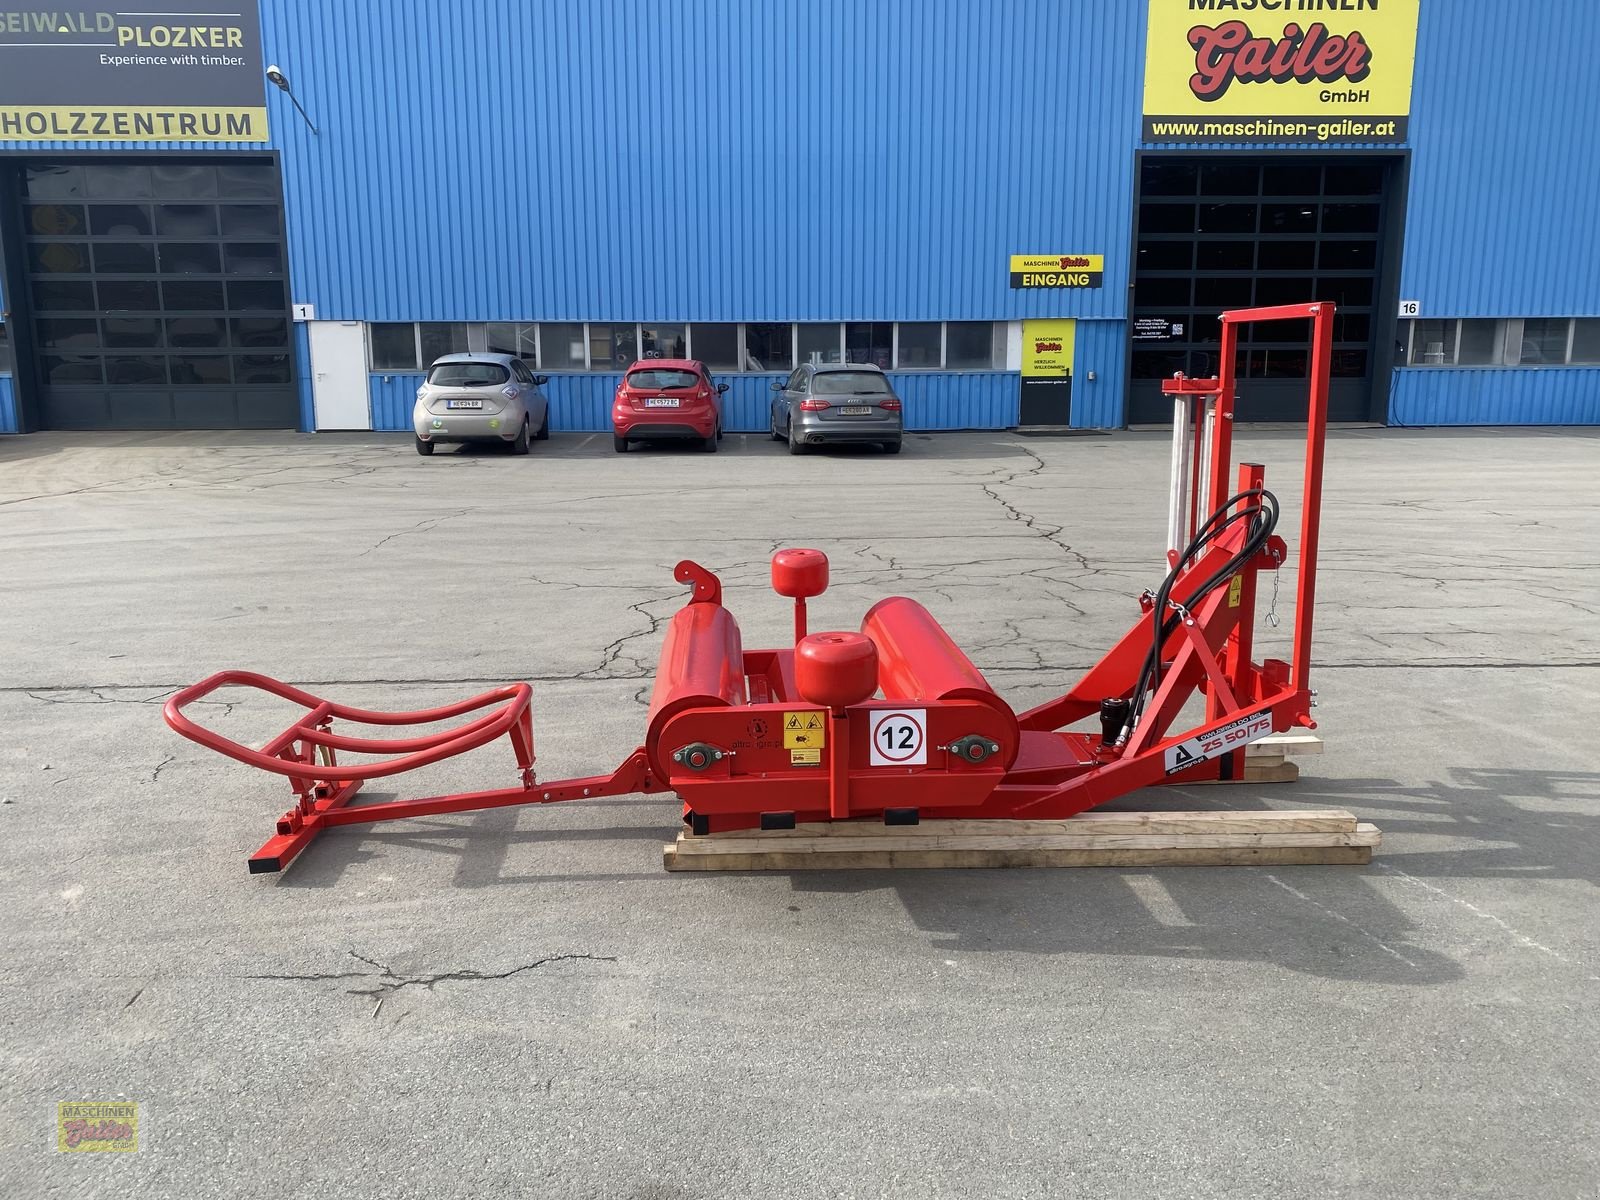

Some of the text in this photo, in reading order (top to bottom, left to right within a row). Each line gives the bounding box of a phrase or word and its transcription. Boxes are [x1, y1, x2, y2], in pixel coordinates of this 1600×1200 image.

[100, 54, 246, 67] Experience with timber.
[1187, 20, 1372, 102] Gailer
[1319, 90, 1370, 103] GmbH
[1, 111, 252, 136] HOLZZENTRUM
[1152, 119, 1396, 141] www.maschinen-gailer.at
[1022, 273, 1090, 286] EINGANG
[300, 306, 306, 318] 1
[1403, 303, 1417, 314] 16
[882, 726, 914, 750] 12
[1201, 718, 1271, 753] ZS 50/75
